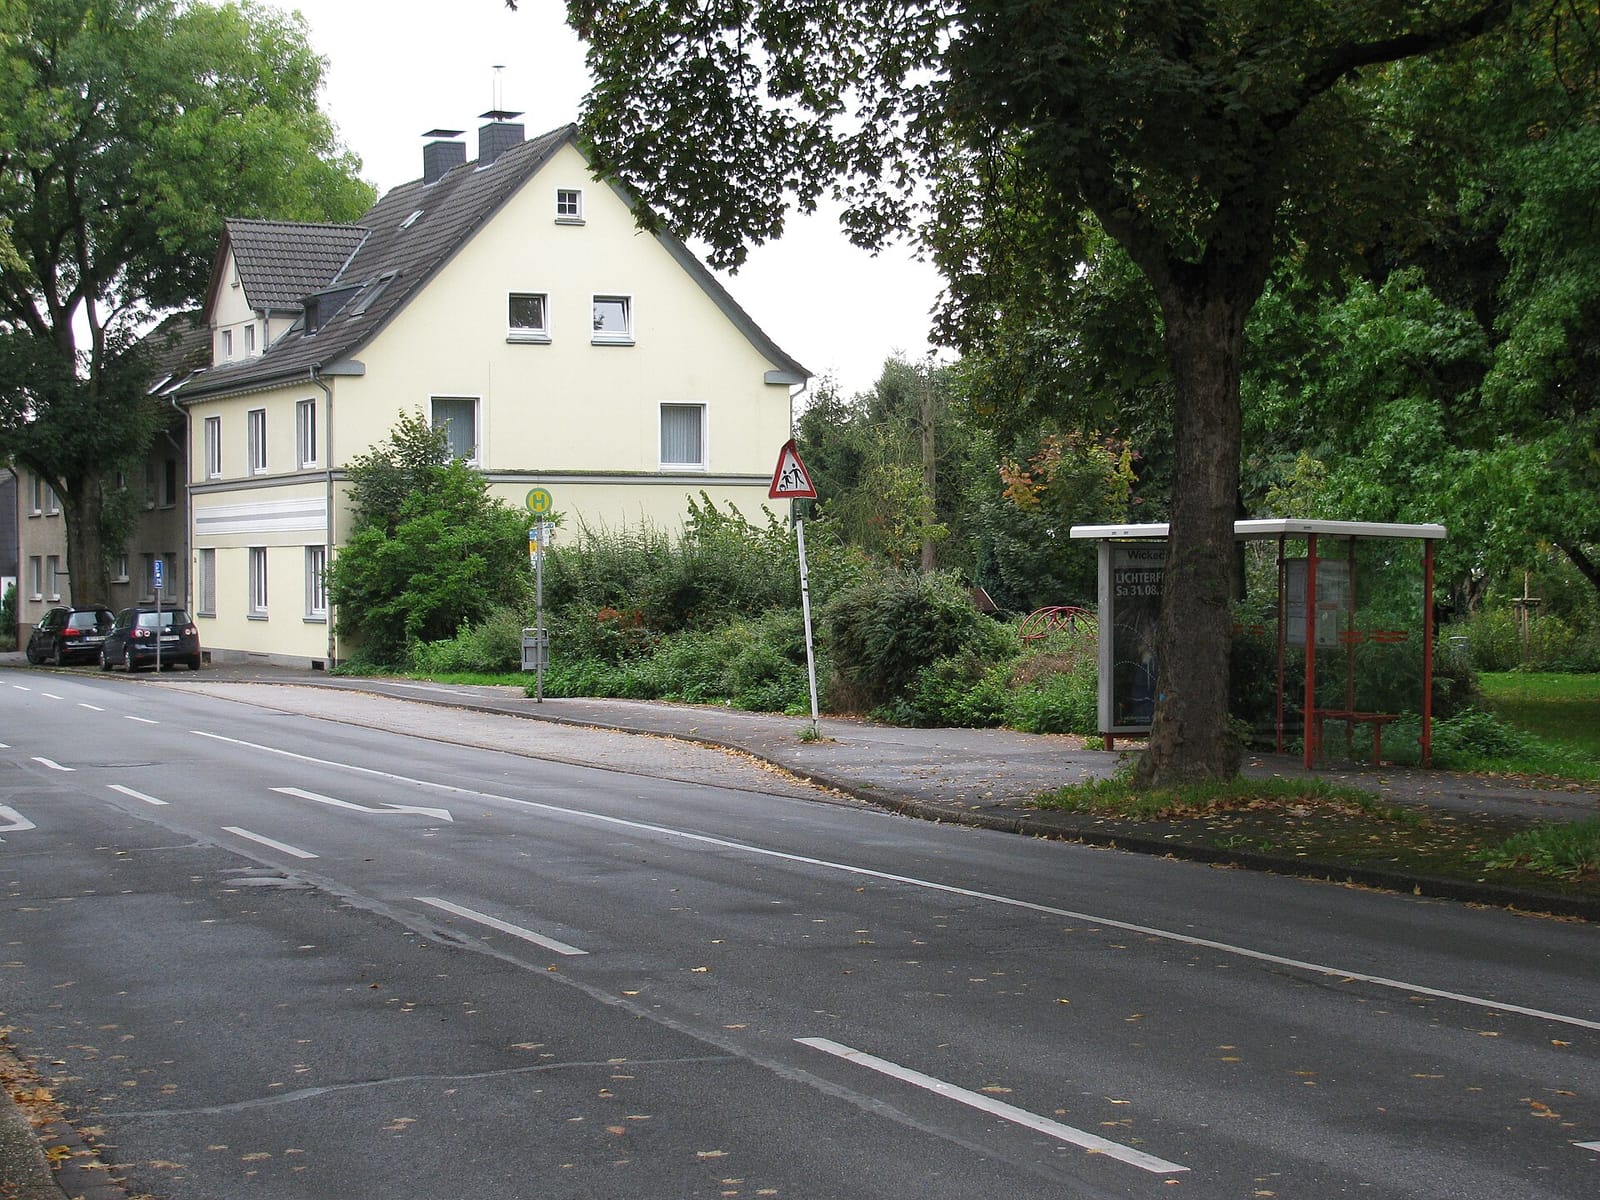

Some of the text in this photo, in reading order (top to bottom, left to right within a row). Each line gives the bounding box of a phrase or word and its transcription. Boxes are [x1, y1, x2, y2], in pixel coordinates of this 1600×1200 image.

[532, 494, 546, 509] H
[1127, 550, 1168, 560] Wicked
[1116, 585, 1128, 597] Sa
